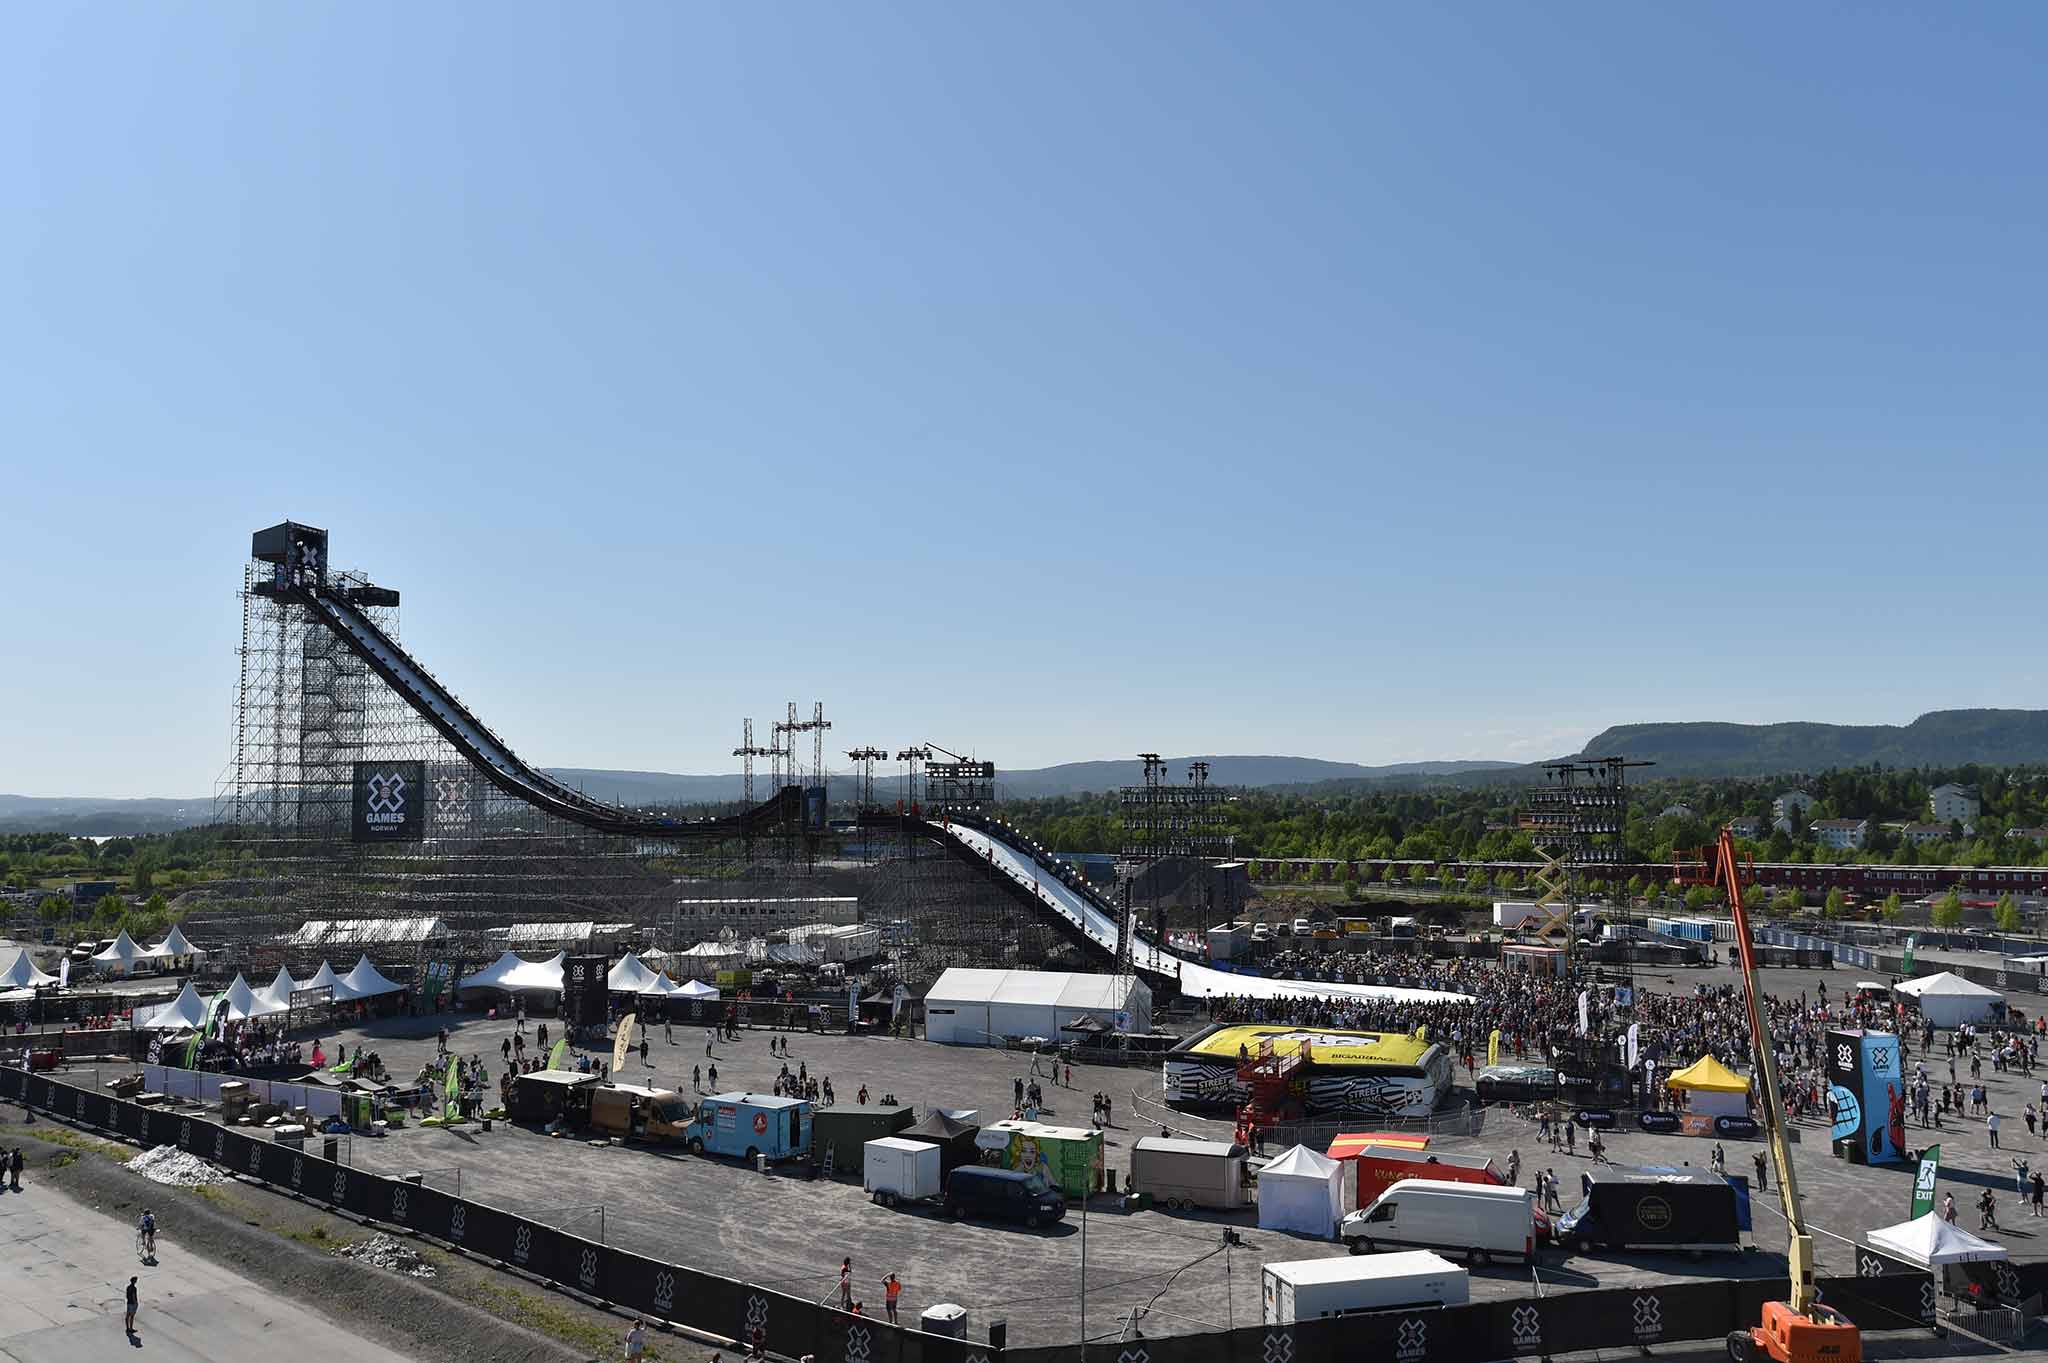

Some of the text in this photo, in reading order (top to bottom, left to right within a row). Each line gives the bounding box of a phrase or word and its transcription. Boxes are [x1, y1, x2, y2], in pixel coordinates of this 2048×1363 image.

[366, 812, 406, 823] GAMES
[1199, 1078, 1227, 1089] STREET
[1348, 1087, 1380, 1099] STREET
[1915, 1190, 1934, 1201] EXIT
